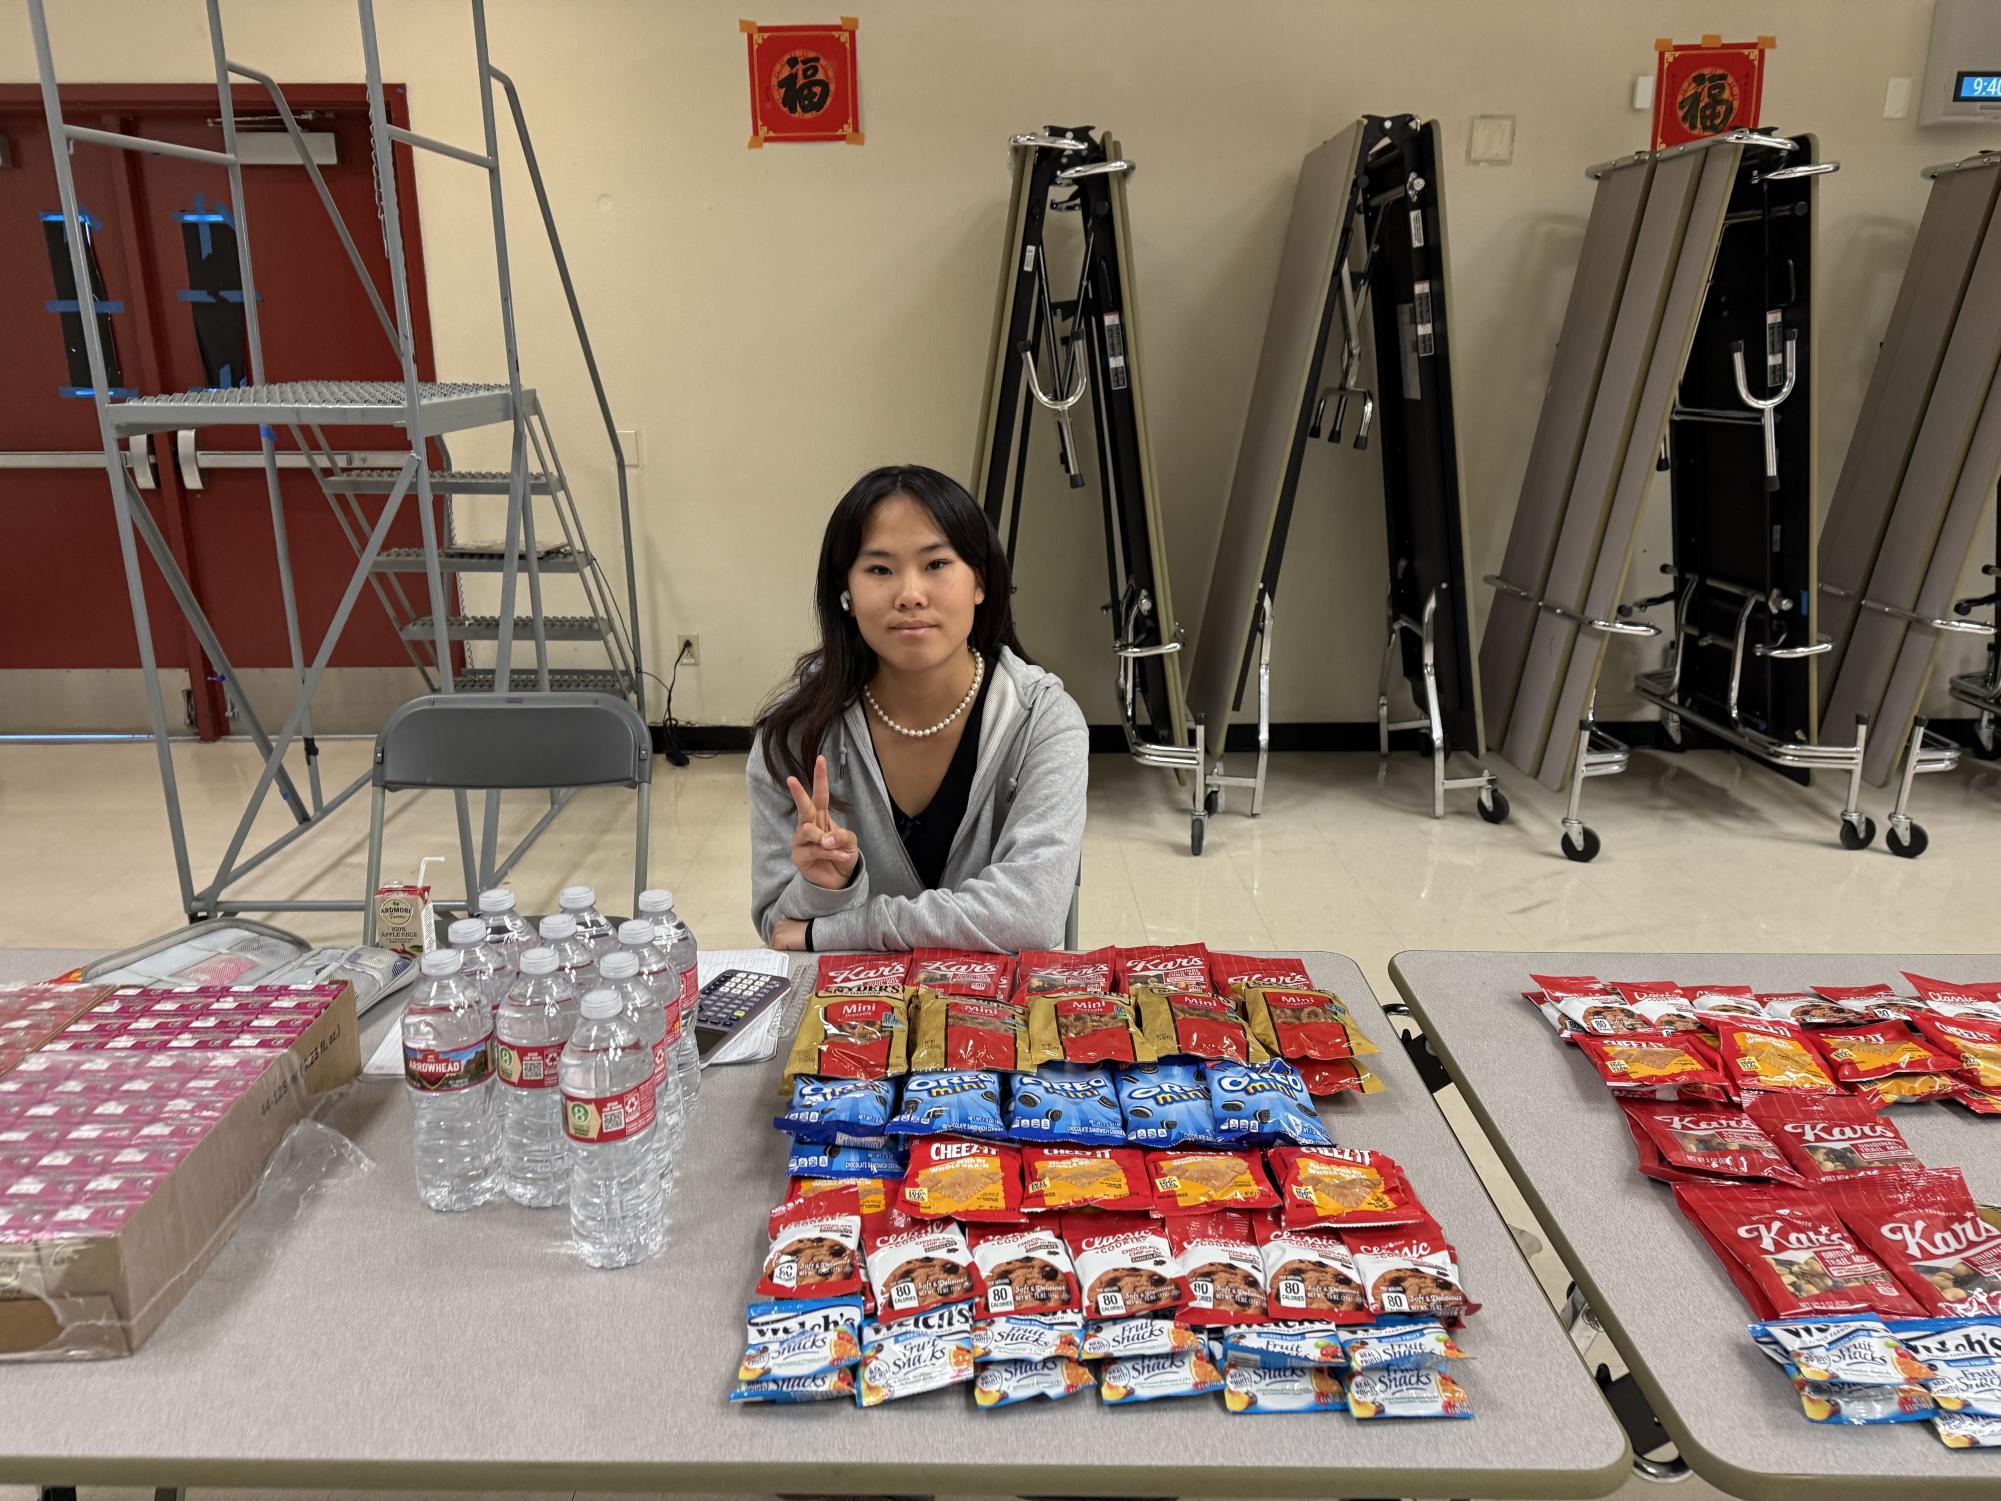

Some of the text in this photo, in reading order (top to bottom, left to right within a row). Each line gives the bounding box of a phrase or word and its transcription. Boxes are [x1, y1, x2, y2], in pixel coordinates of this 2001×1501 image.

[777, 56, 830, 114] 福
[1678, 73, 1734, 132] 福
[381, 906, 412, 914] ARDMORE
[920, 961, 997, 973] Kar's
[1127, 955, 1203, 972] Kar's
[828, 962, 905, 983] Kar's
[1072, 1001, 1105, 1010] Mini
[1184, 997, 1217, 1007] Mini
[1281, 995, 1315, 1004] Mini
[842, 1003, 876, 1015] Mini
[965, 1005, 998, 1015] Mini
[1595, 1020, 1607, 1028] 80
[408, 1060, 460, 1073] ARROWHEAD
[906, 1073, 993, 1091] OREO
[930, 1082, 986, 1097] mini
[1784, 1122, 1895, 1142] Kar's
[1857, 1142, 1898, 1150] ORIGINAL
[1082, 1229, 1152, 1250] Classic
[1270, 1231, 1340, 1245] Classic
[1737, 1221, 1850, 1252] Kar's
[1880, 1220, 2001, 1260] Kar's
[1100, 1236, 1148, 1254] COOKIES
[1360, 1240, 1430, 1259] Classic
[1825, 1254, 1870, 1266] TRAIL MIX
[896, 1285, 911, 1297] 80
[992, 1287, 1008, 1301] 80
[1014, 1285, 1029, 1294] Soft
[1194, 1283, 1209, 1295] 80
[1284, 1282, 1300, 1294] 80
[1103, 1294, 1118, 1305] 80
[1124, 1293, 1138, 1301] Soft
[1388, 1293, 1403, 1307] 80
[1410, 1295, 1425, 1303] Soft
[1007, 1326, 1044, 1338] Fruit
[1121, 1320, 1156, 1337] Fruit
[994, 1331, 1050, 1347] Snacks
[1112, 1326, 1164, 1348] Snacks
[771, 1336, 828, 1360] Snacks
[1265, 1340, 1303, 1354] Fruit
[1004, 1360, 1058, 1381] Snacks
[1131, 1357, 1186, 1380] Snacks
[1253, 1367, 1306, 1384] Snacks
[1960, 1369, 1998, 1379] Fruit
[1378, 1371, 1432, 1393] Snacks
